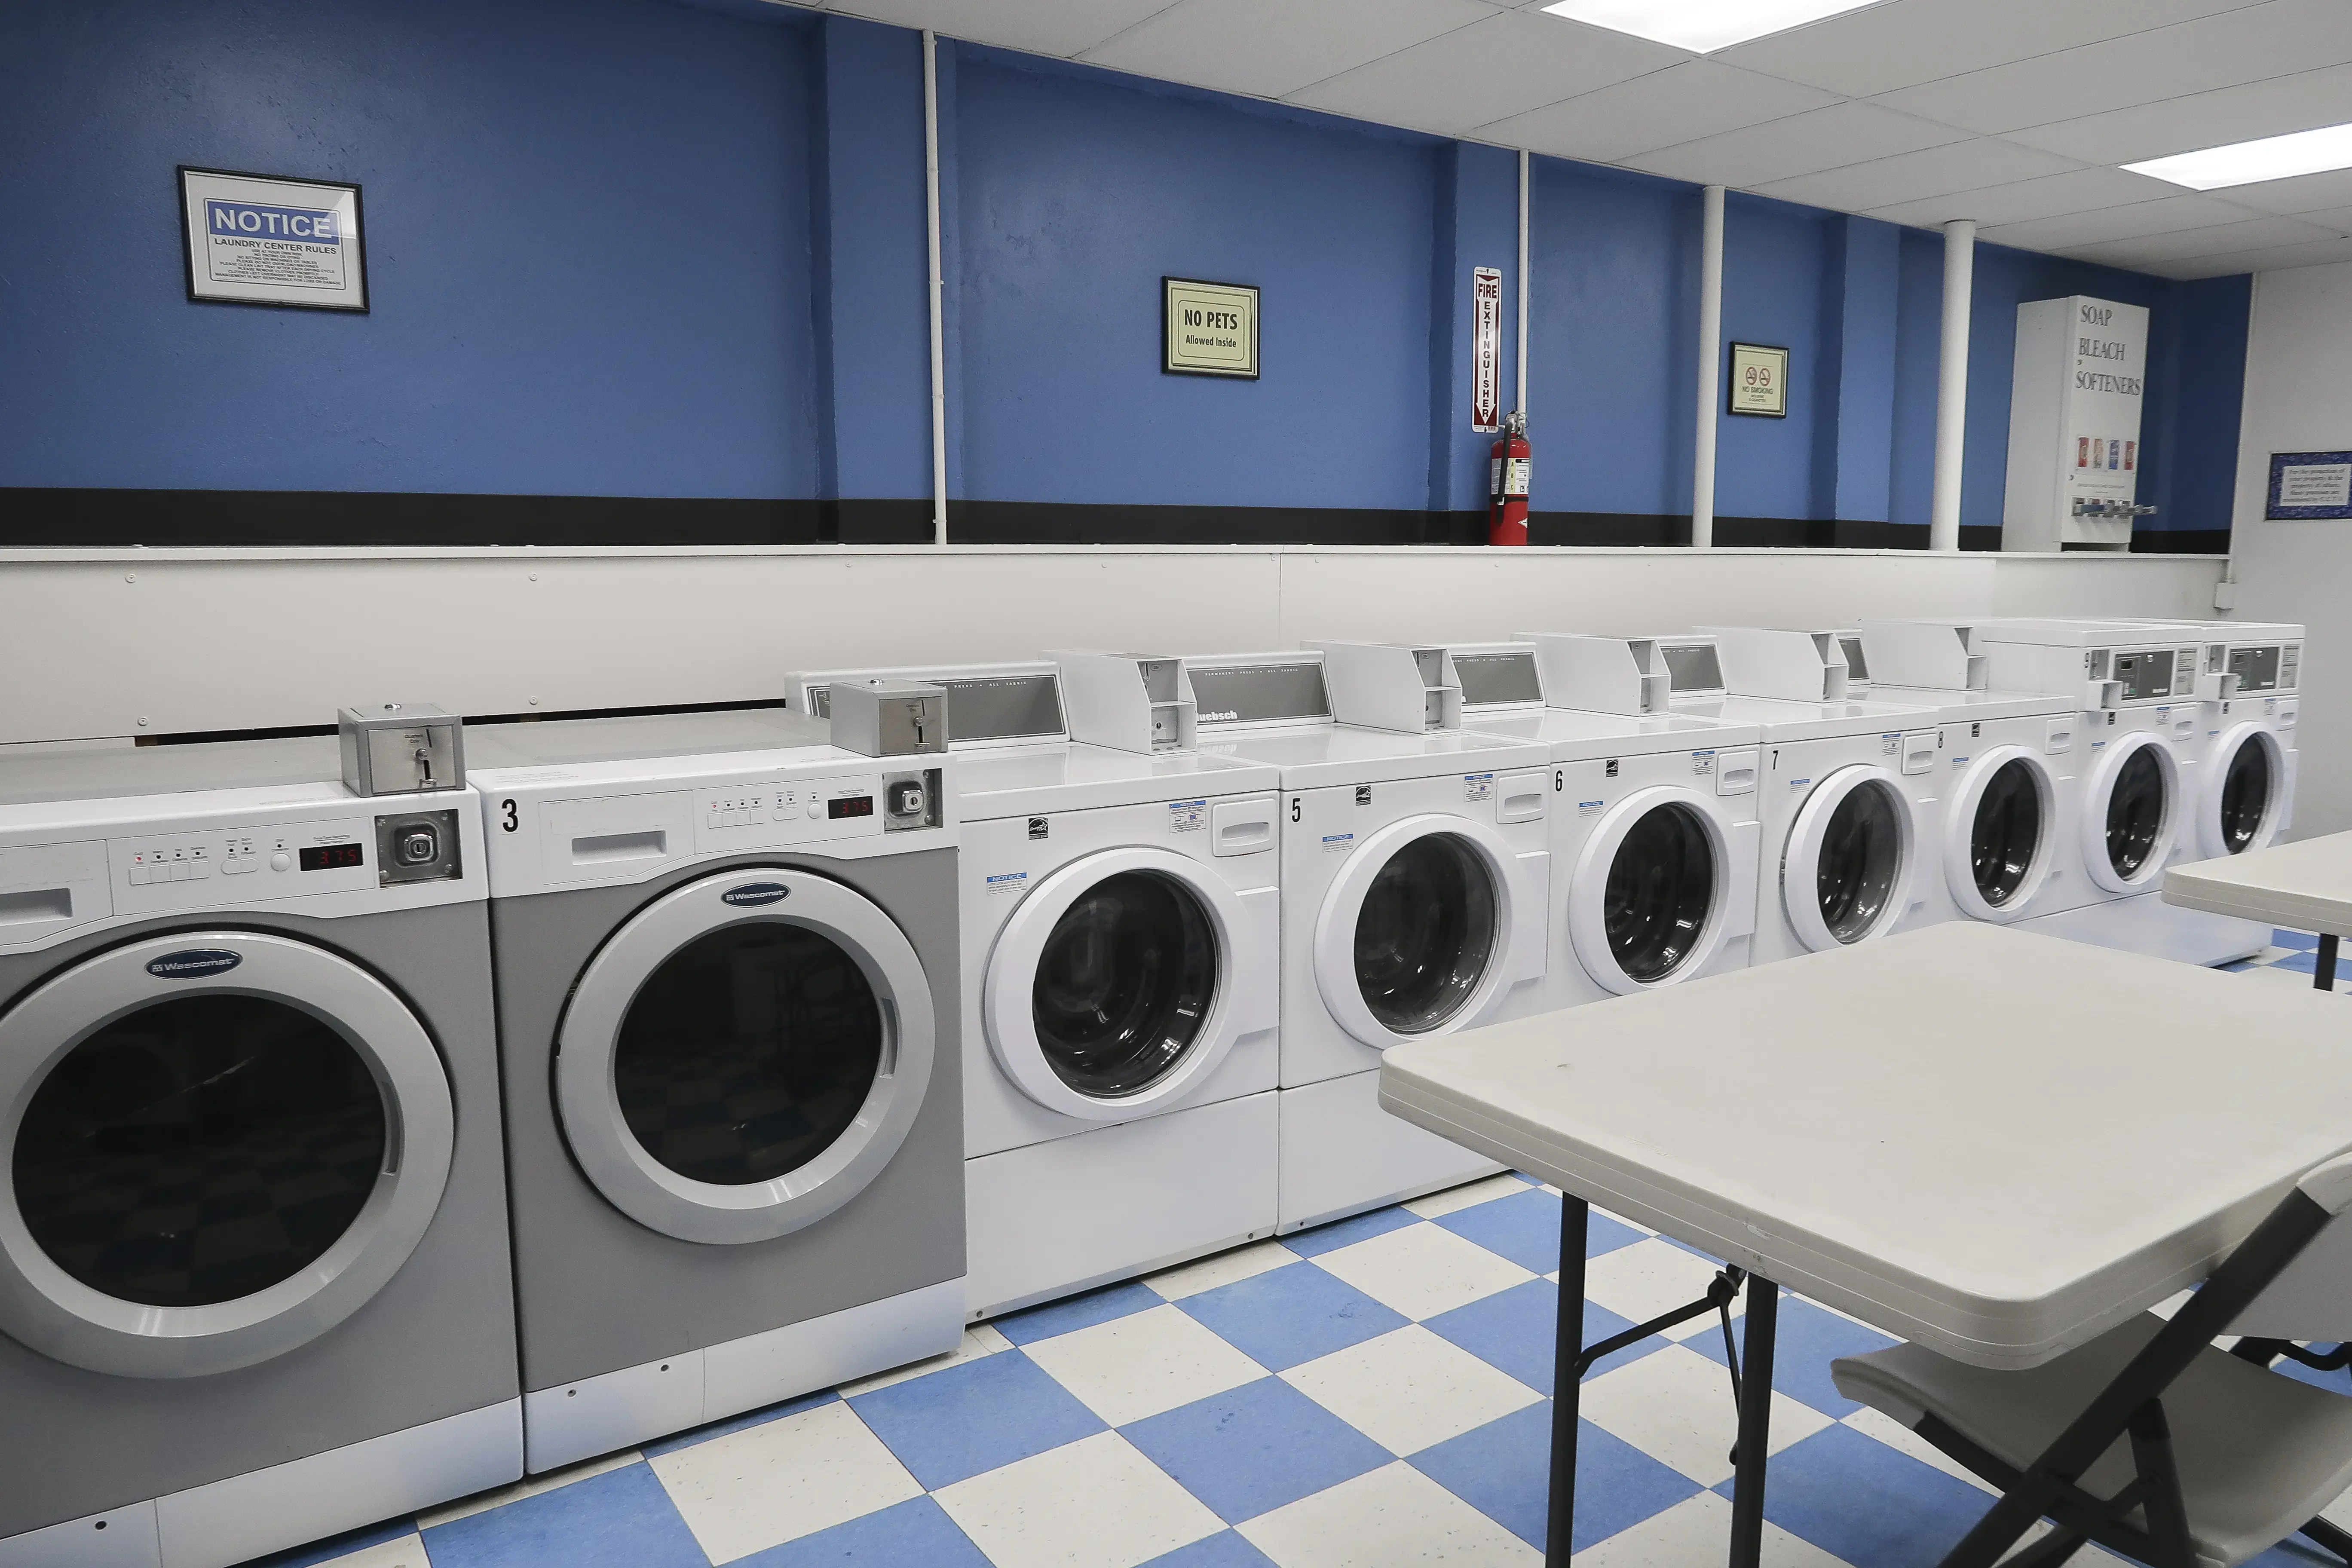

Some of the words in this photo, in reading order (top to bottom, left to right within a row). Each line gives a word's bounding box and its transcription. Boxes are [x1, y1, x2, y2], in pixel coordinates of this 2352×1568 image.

[214, 208, 332, 239] NOTICE
[215, 238, 260, 249] LAUNDRY
[264, 242, 303, 252] CENTER
[306, 246, 337, 254] RULES
[1478, 283, 1497, 299] FIRE
[1185, 309, 1202, 327] NO
[1207, 312, 1237, 330] PETS
[2080, 304, 2113, 327] SOAP
[1185, 334, 1214, 346] Allowed
[1216, 337, 1236, 348] Inside
[2079, 337, 2126, 361] BLEACH
[1482, 301, 1491, 418] EXTINGUISHER
[2076, 371, 2141, 396] SOFTENERS
[1772, 750, 1779, 770] 7
[1555, 770, 1563, 792] 6
[501, 798, 519, 833] 3
[1291, 798, 1302, 823] 5
[735, 890, 786, 900] Wascomat
[164, 958, 235, 971] Wascomat
